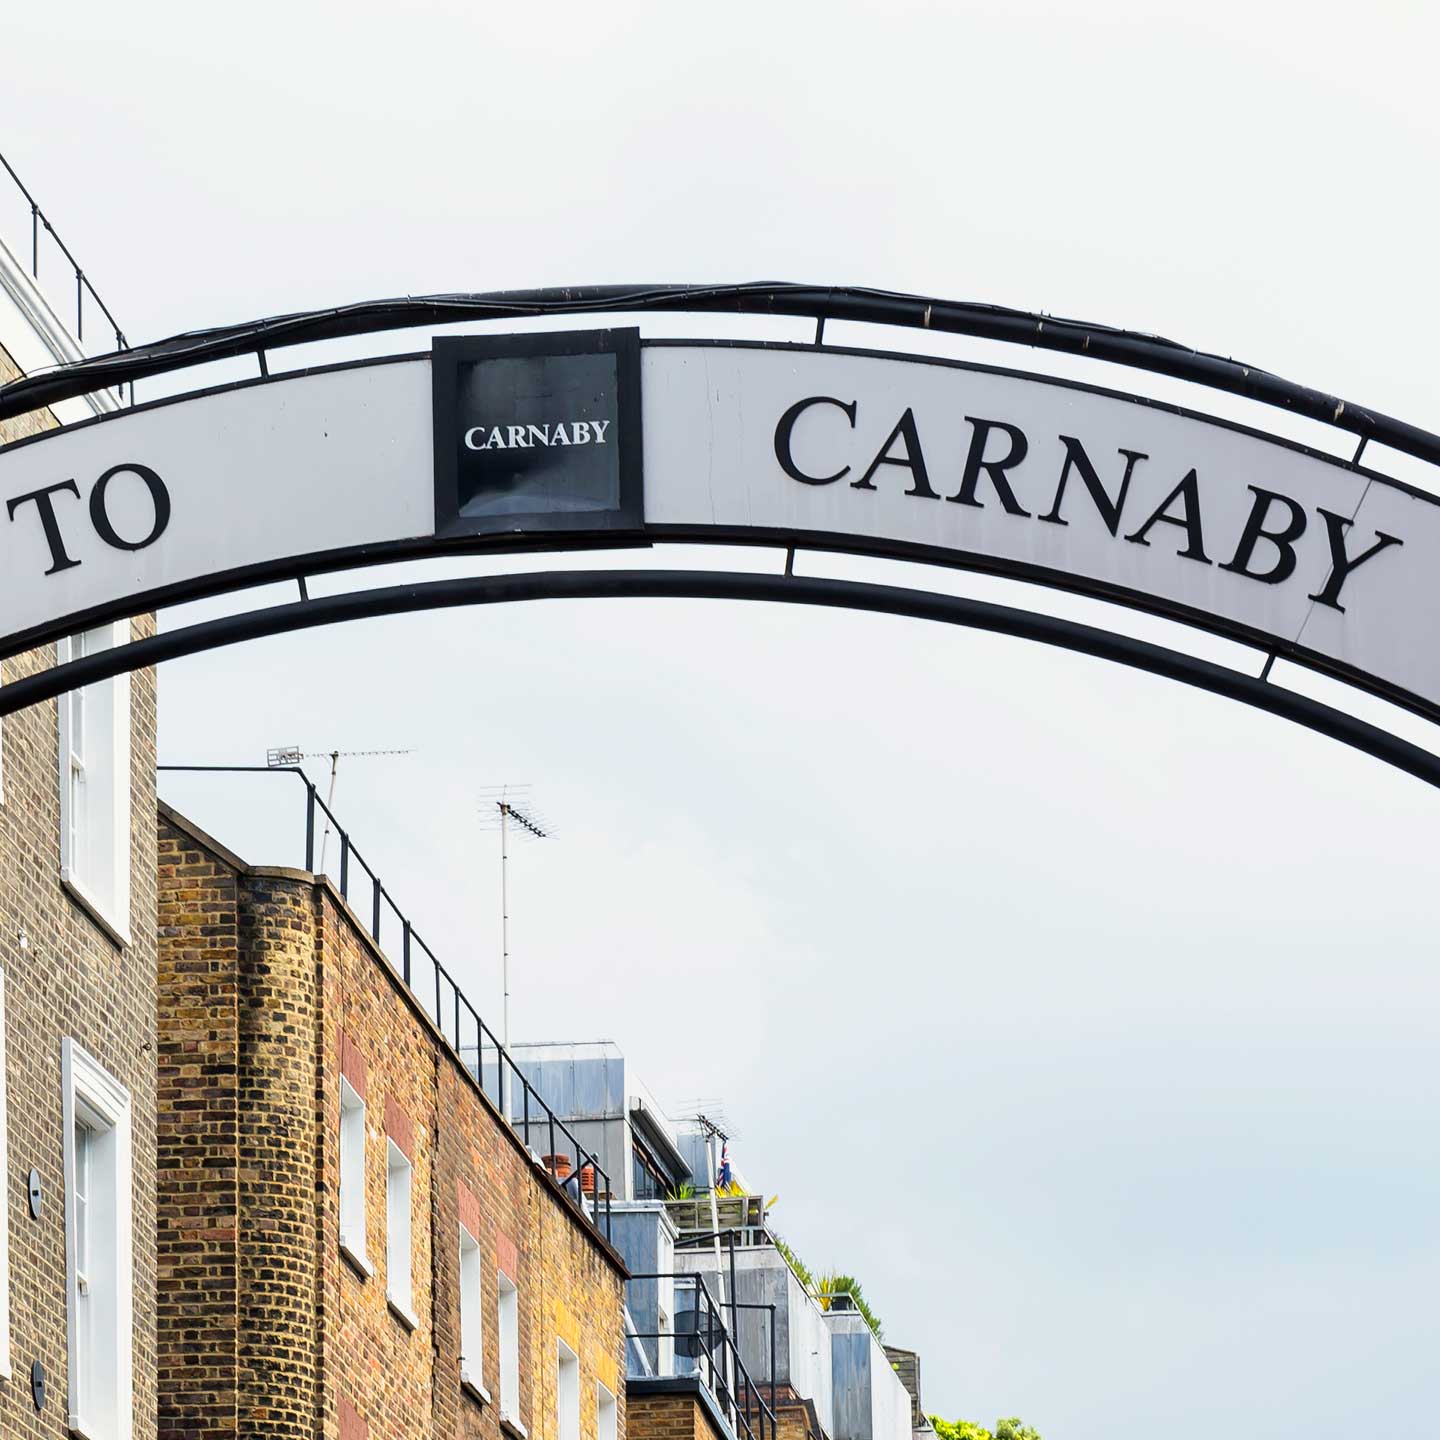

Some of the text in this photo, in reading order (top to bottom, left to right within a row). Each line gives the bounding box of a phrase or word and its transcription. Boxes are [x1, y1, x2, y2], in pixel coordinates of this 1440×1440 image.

[464, 420, 610, 450] CARNABY
[7, 463, 171, 577] TO
[773, 396, 1403, 614] CARNABY
